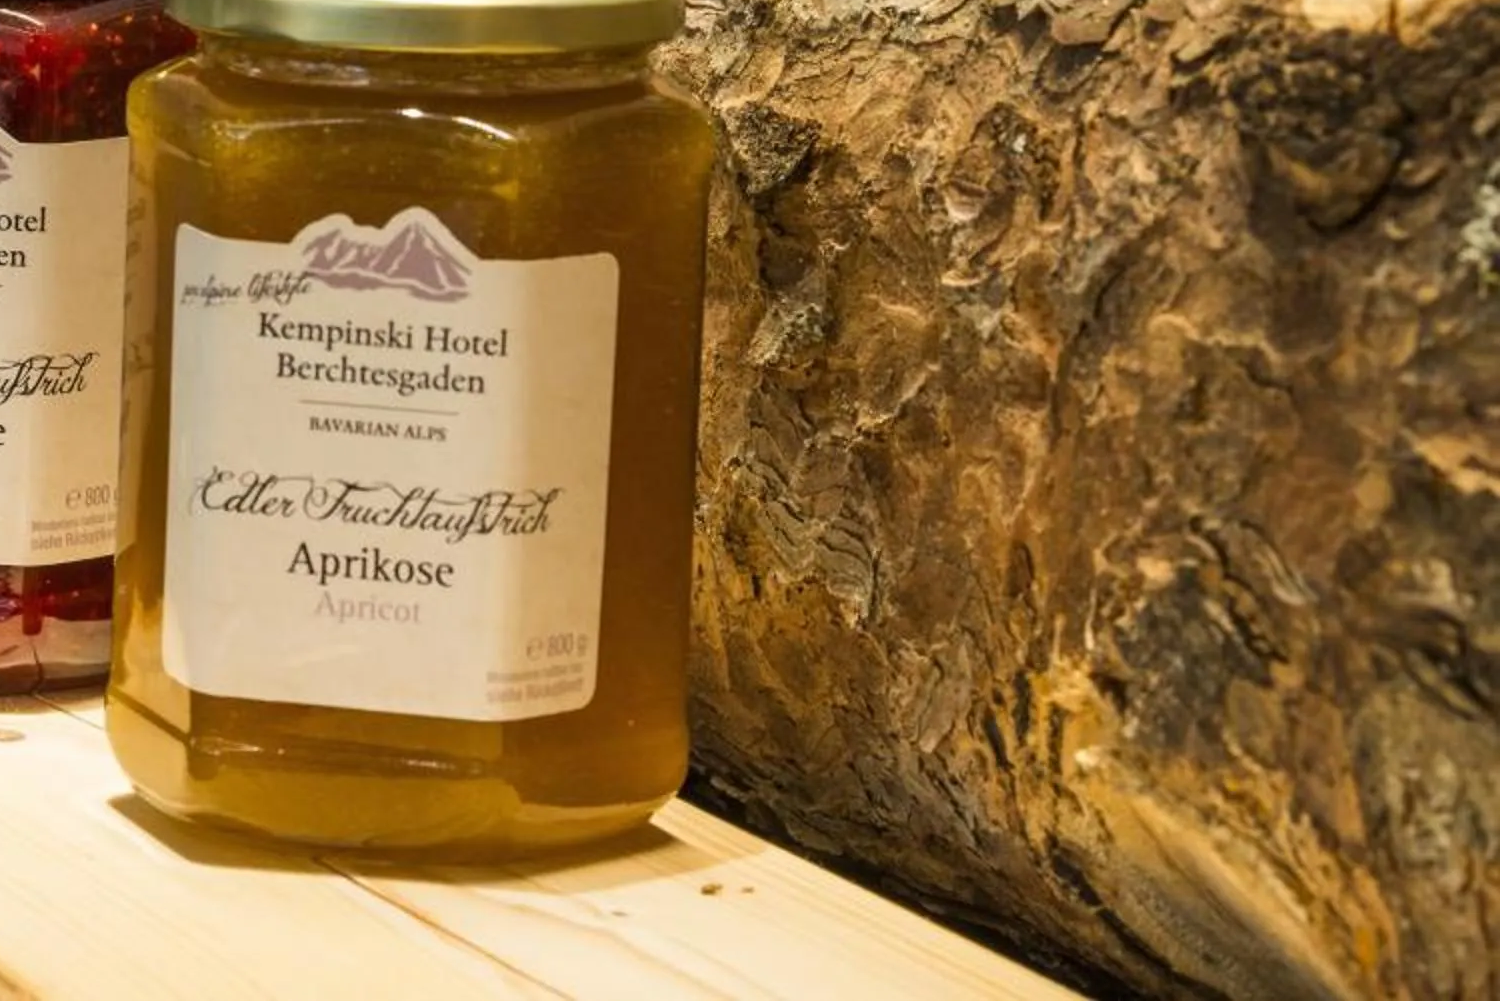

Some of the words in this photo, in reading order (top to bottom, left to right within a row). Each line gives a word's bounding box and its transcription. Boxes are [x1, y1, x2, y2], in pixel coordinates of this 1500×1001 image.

[258, 312, 413, 349] Kempinski
[425, 326, 509, 357] Hotel
[276, 353, 486, 395] Berchtesgaden
[309, 417, 398, 439] BAVARIAN
[403, 424, 447, 442] ALPS
[193, 466, 296, 515] Edler
[303, 475, 564, 543] Fruchtaufstrich
[287, 542, 455, 588] Aprikose
[314, 591, 421, 624] Apricot
